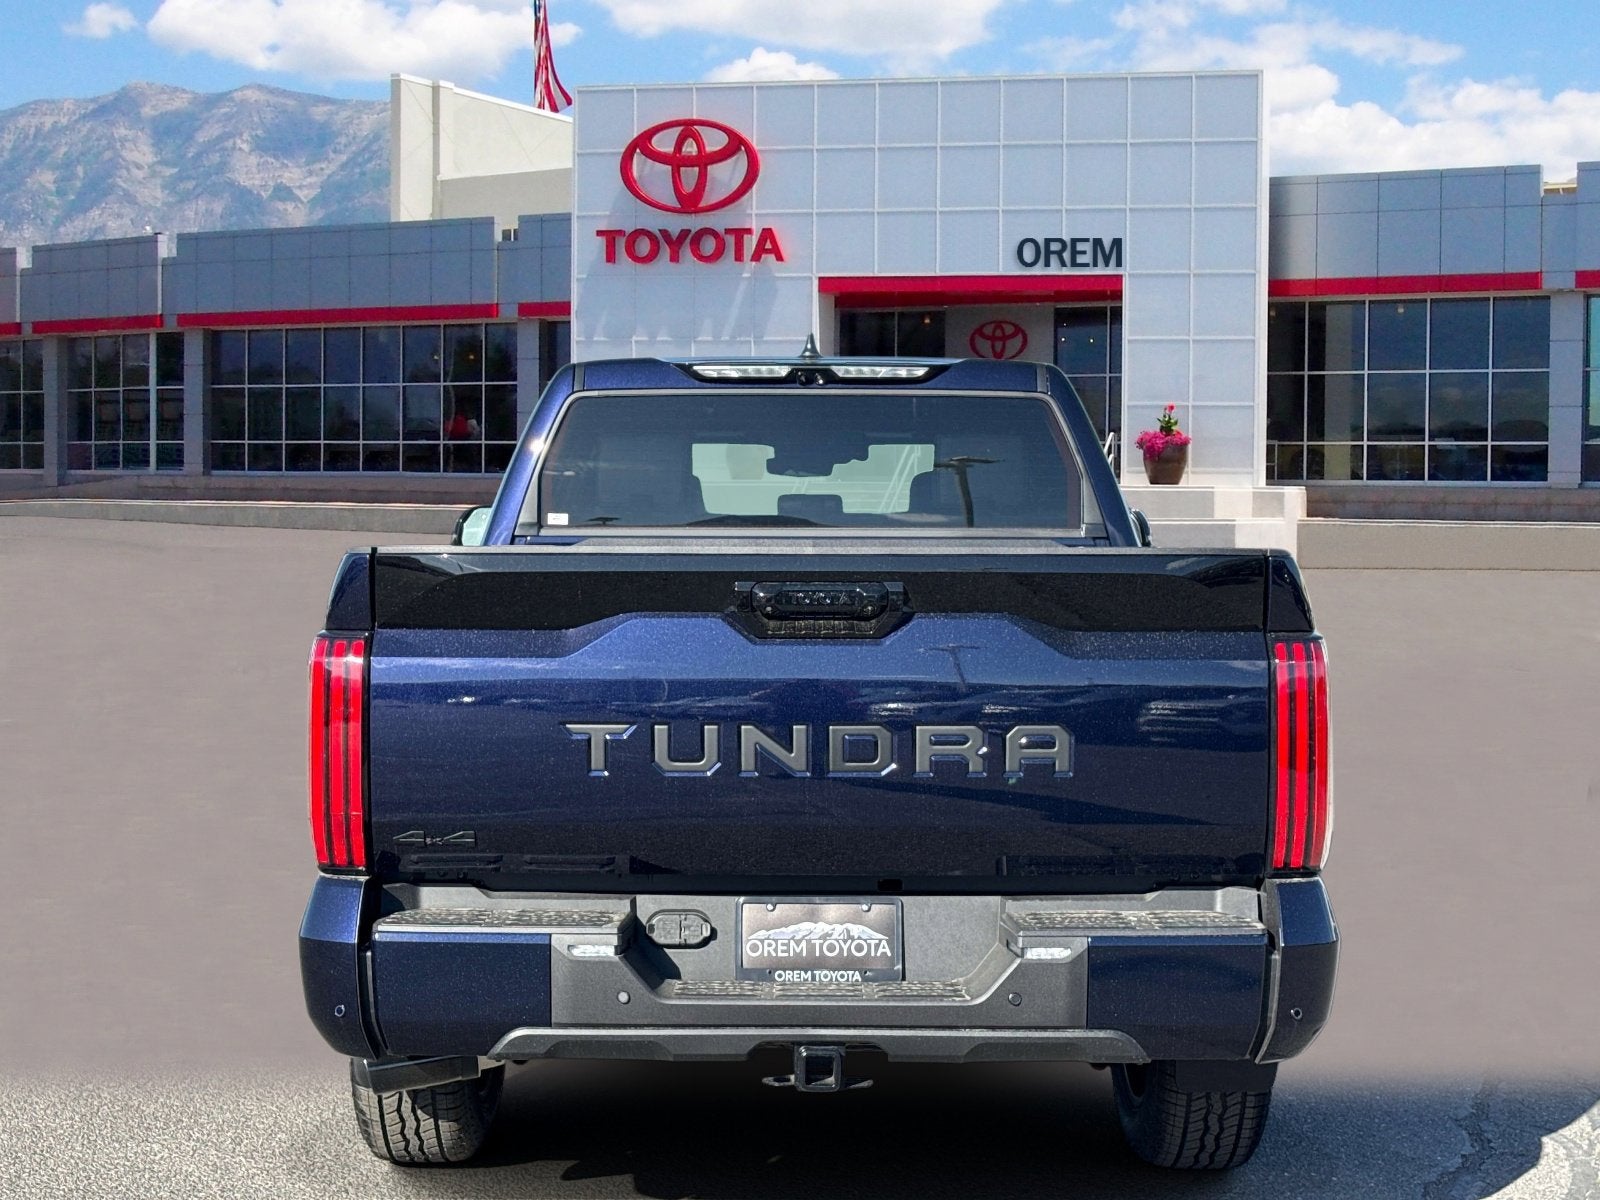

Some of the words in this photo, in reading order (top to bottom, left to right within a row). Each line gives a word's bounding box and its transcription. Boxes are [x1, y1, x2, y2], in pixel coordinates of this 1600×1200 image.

[596, 227, 785, 264] TOYOTA
[1017, 238, 1123, 267] OREM
[564, 723, 1076, 779] TUNDRA
[746, 939, 807, 957] OREM
[812, 939, 891, 957] TOYOTA
[774, 970, 811, 982] OREM
[815, 970, 862, 982] TOYOTA
